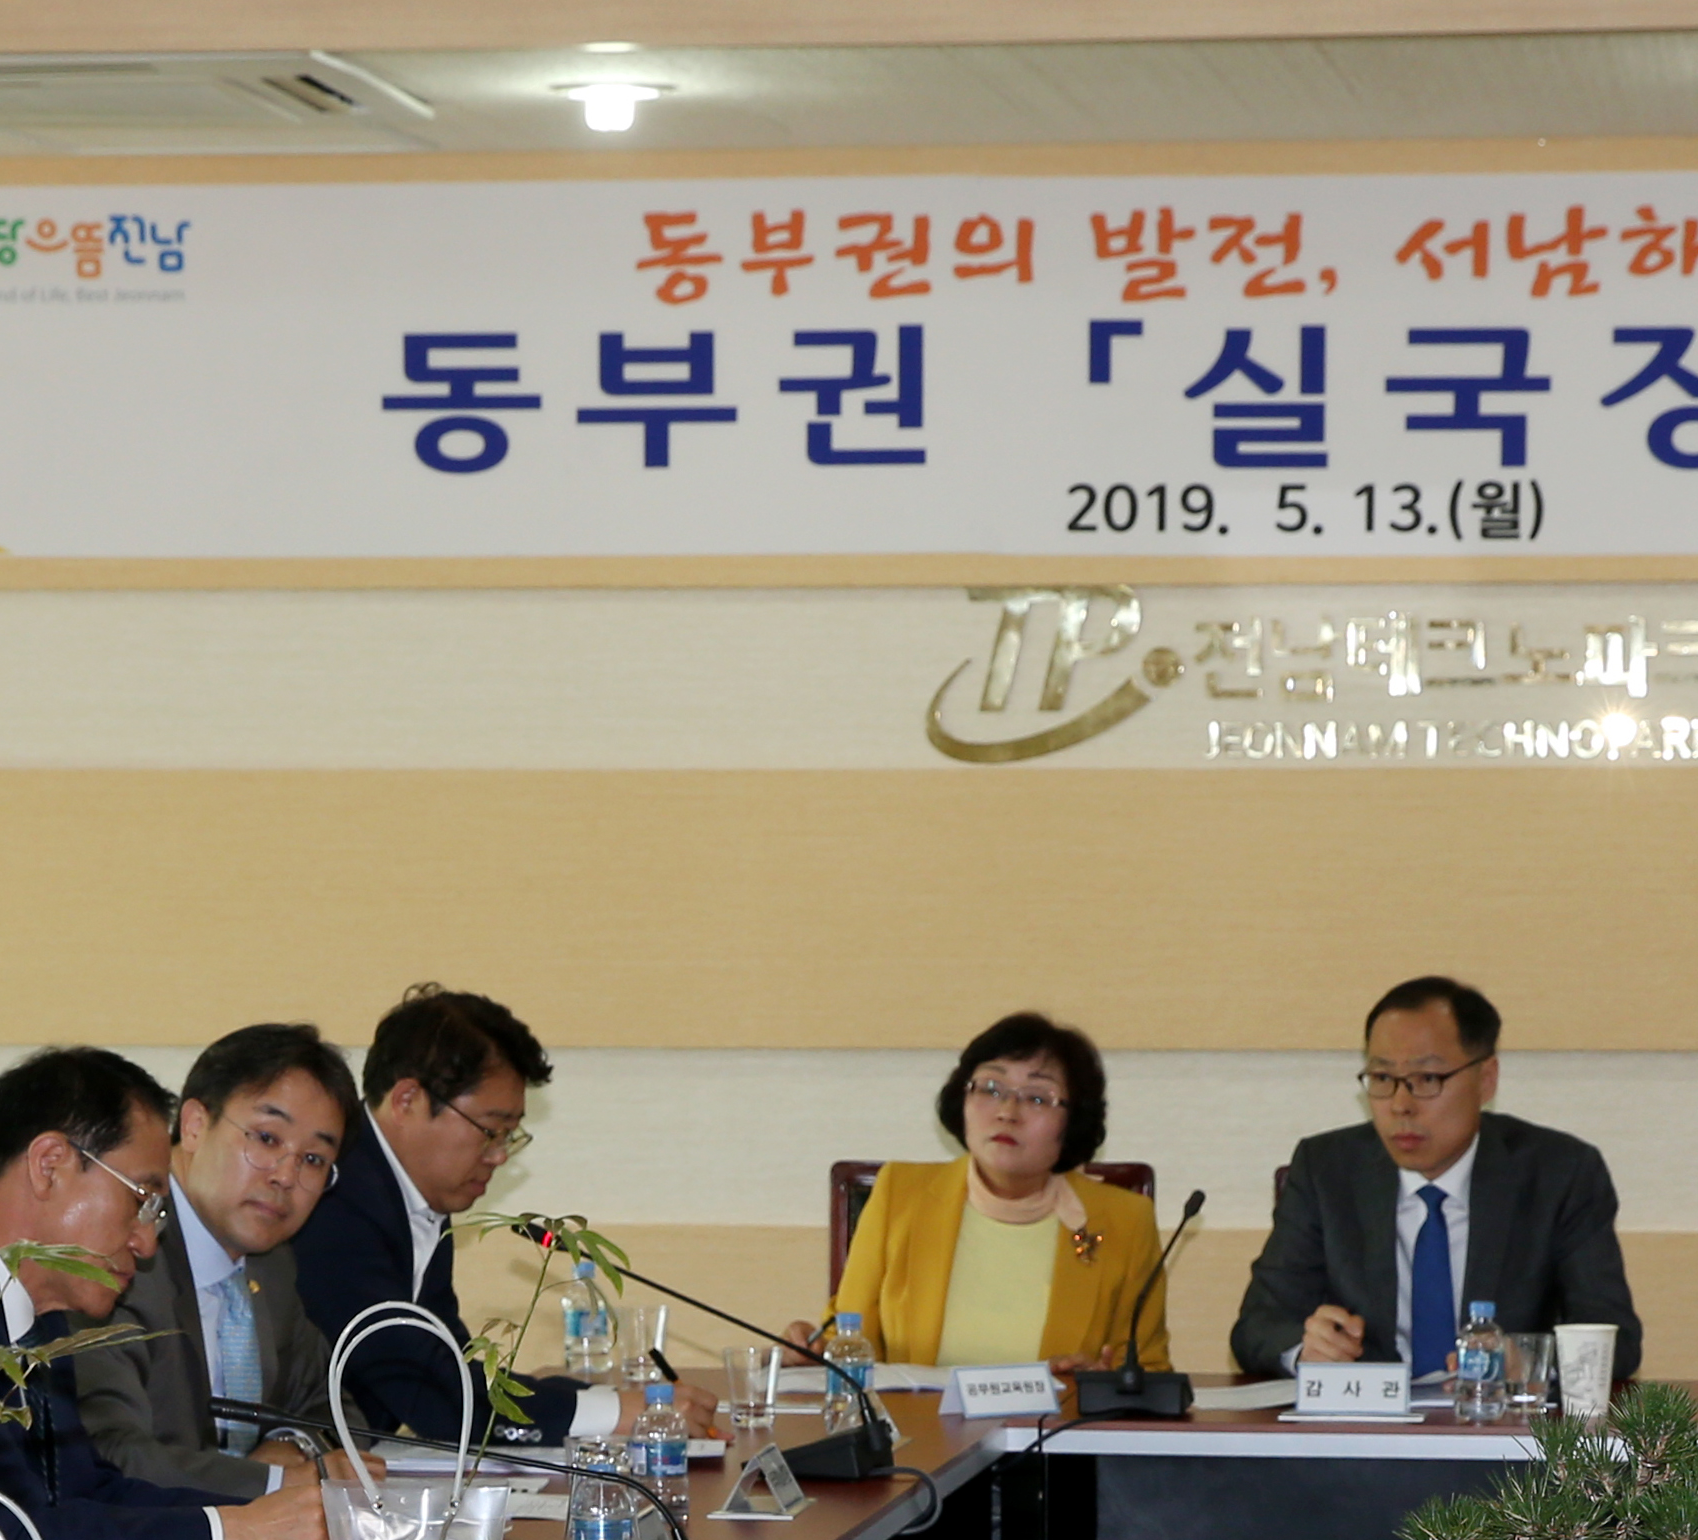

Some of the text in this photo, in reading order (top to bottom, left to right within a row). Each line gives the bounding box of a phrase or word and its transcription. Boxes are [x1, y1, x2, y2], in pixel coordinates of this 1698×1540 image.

[635, 205, 1041, 304] 동부권의
[1088, 203, 1339, 302] 발전,
[382, 324, 928, 474] 동부권
[1066, 483, 1230, 536] 2019.
[1275, 483, 1325, 536] 5.
[1203, 719, 1409, 762] JEONNAM
